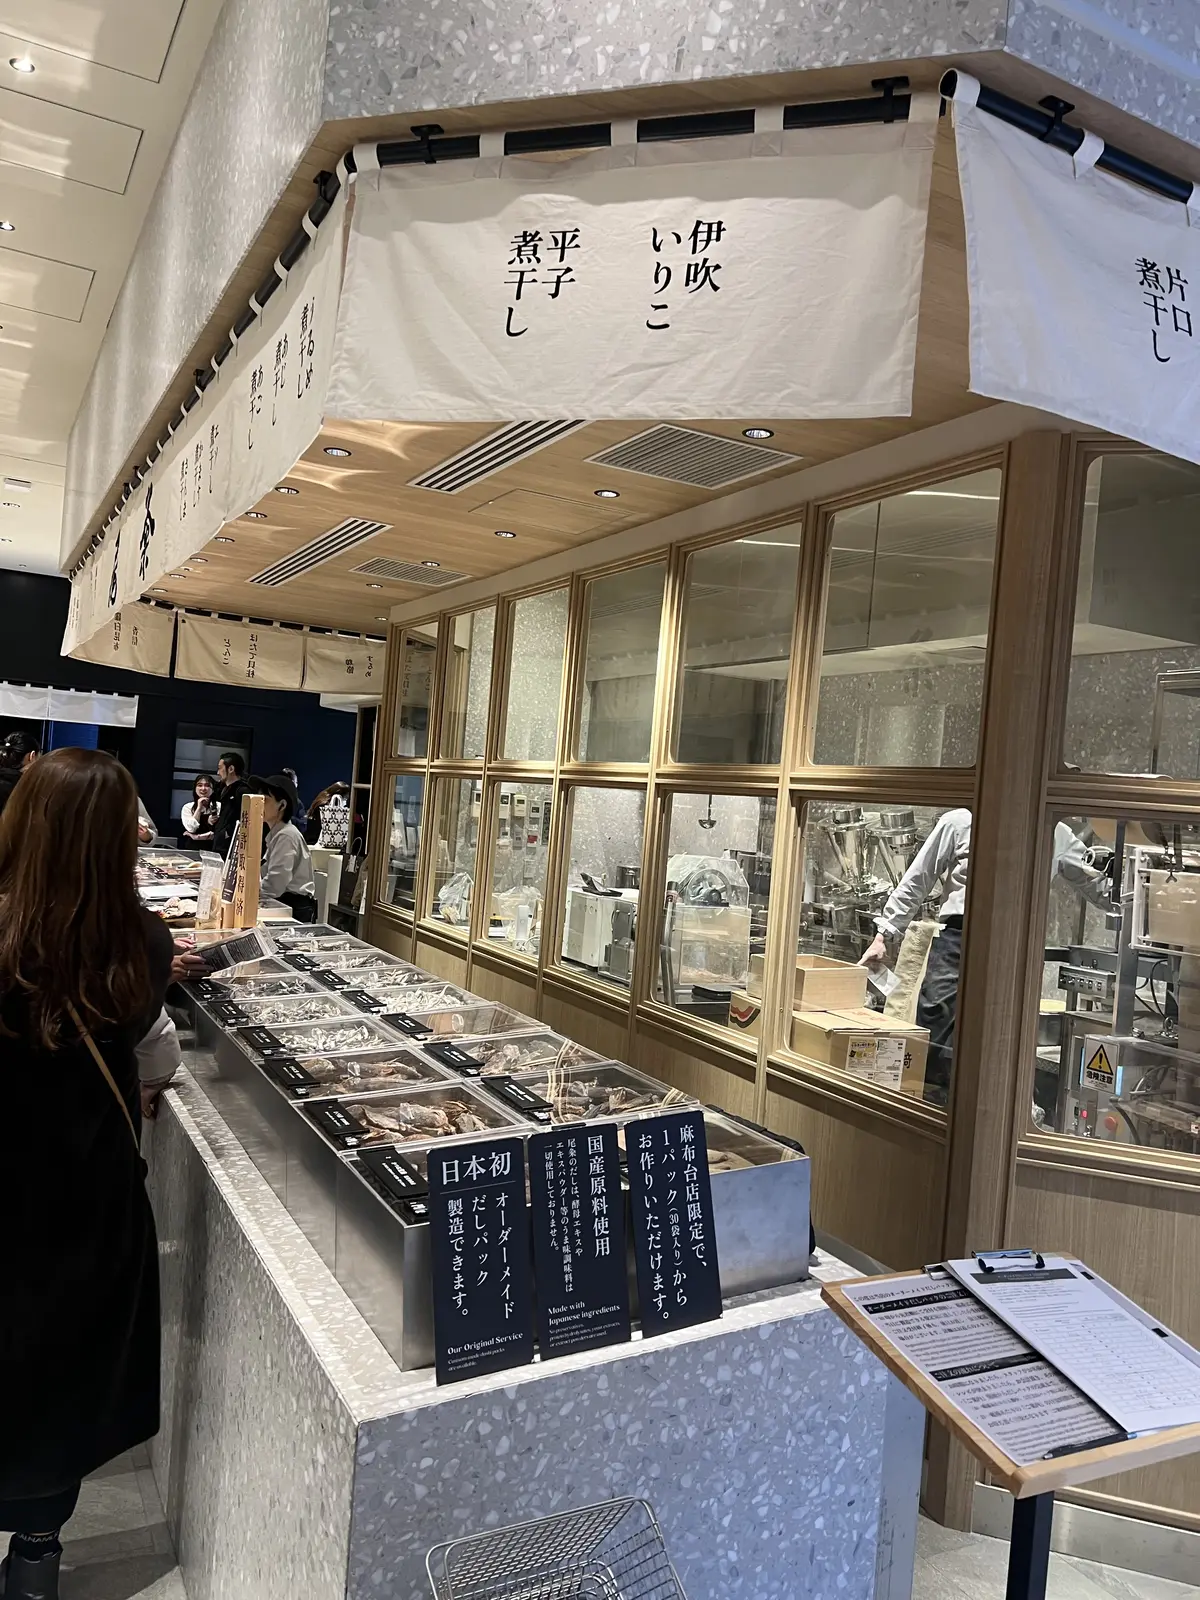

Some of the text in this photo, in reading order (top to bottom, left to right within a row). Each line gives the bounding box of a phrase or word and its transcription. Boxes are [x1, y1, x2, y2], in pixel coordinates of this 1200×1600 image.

[503, 230, 544, 338] 煮干し
[541, 227, 581, 300] 平子
[646, 227, 682, 330] いりこ
[685, 219, 727, 294] 伊吹
[1165, 266, 1193, 337] 片口
[297, 302, 310, 400] 煮干し
[305, 296, 316, 390] うるめ
[1134, 257, 1171, 363] 煮干し
[256, 364, 264, 415] あご
[271, 339, 284, 427] 煮干し
[279, 332, 289, 390] あじ
[247, 368, 259, 451] 煮干し
[235, 810, 248, 917] 特許取得済
[1086, 1070, 1113, 1085] 危険注意
[441, 1151, 512, 1186] 日本初
[543, 1145, 560, 1251] 一切使用しておりません。
[567, 1137, 584, 1257] 尾粂のだしは、酵母エキスや
[587, 1134, 611, 1258] 国産原料使用
[679, 1124, 708, 1267] 麻布台店限定で、
[447, 1198, 469, 1317] 製造できます。
[472, 1193, 489, 1287] だしパック
[495, 1191, 517, 1320] オーダーメイド
[556, 1141, 574, 1293] エキスパウダー等のうま味調味料は
[638, 1133, 670, 1320] お作りいただけます。
[447, 1332, 524, 1355] Our Original Service
[548, 1301, 586, 1315] Made with
[549, 1304, 621, 1326] Japanese ingredients
